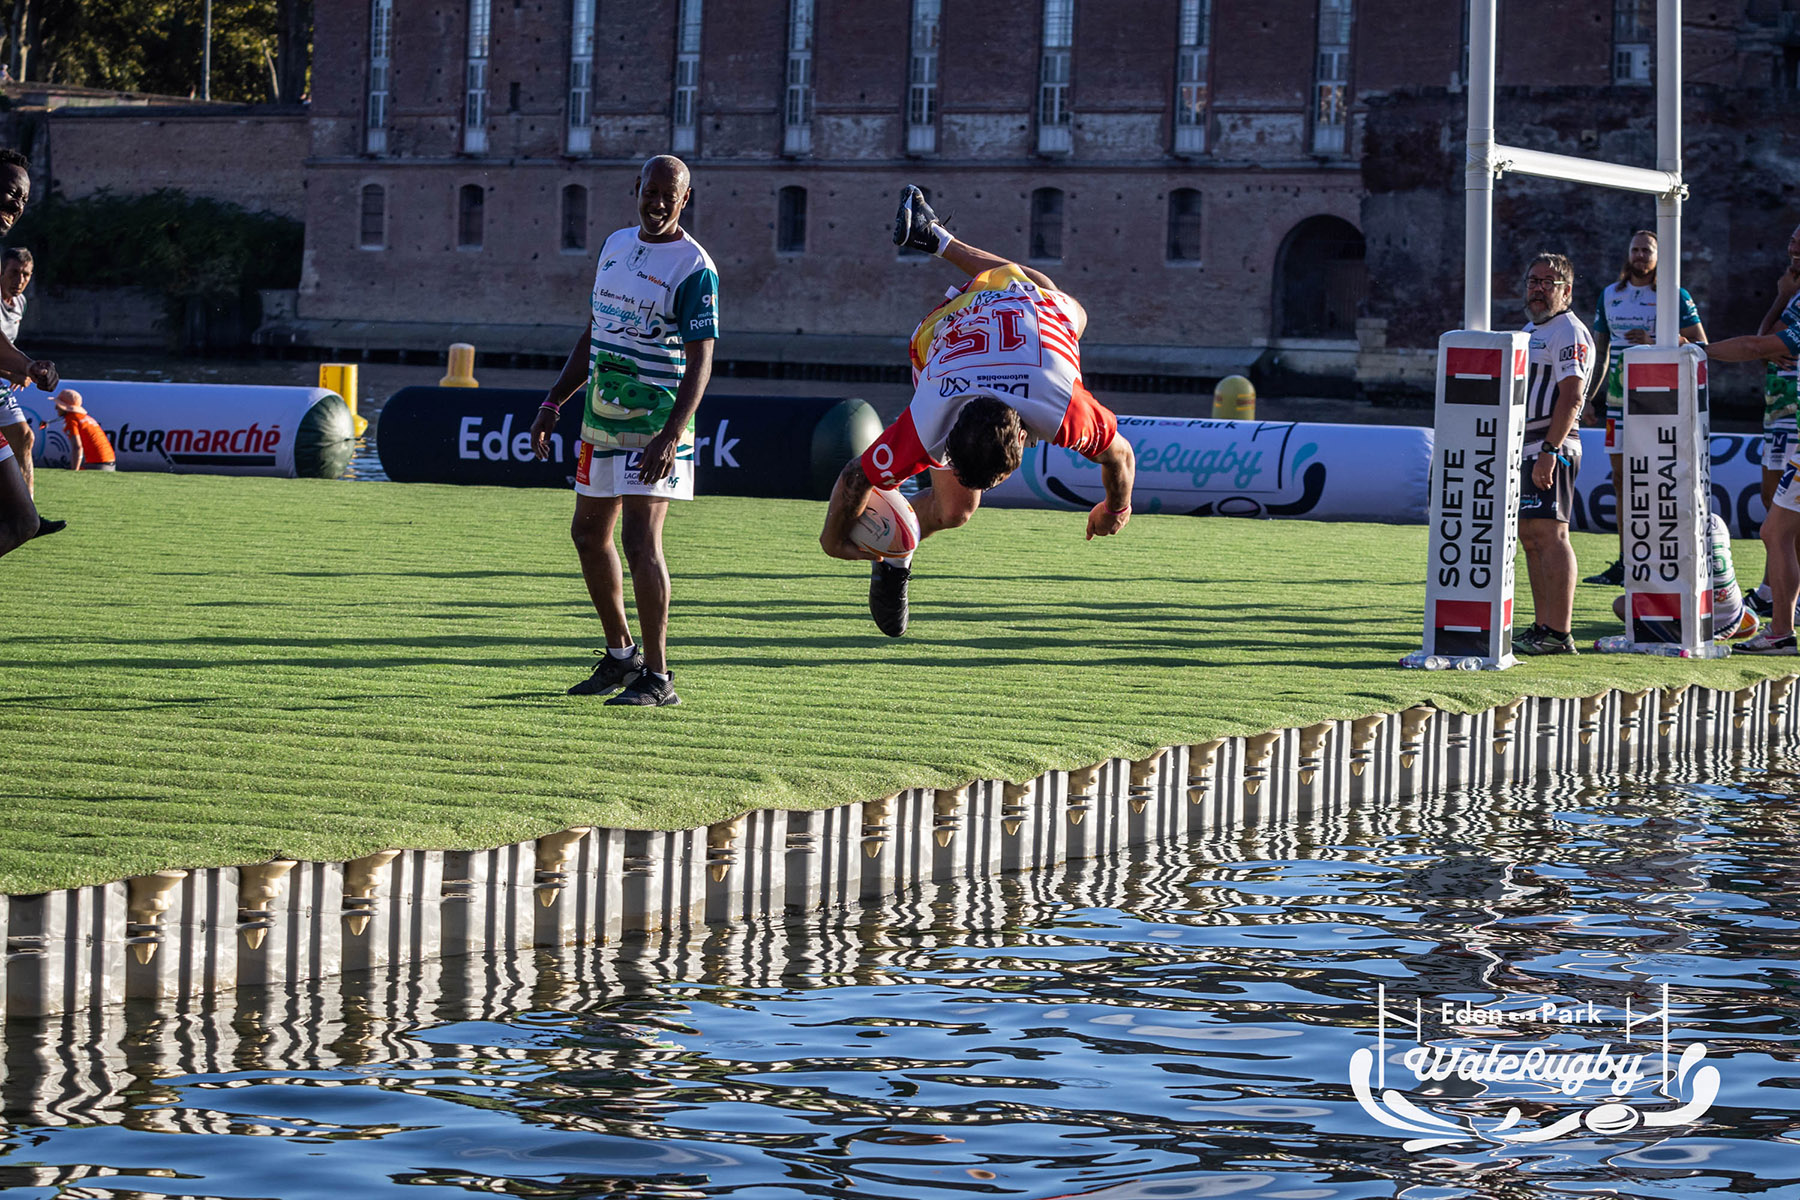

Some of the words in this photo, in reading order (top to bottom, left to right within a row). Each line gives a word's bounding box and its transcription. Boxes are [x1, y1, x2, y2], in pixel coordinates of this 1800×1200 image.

[600, 289, 615, 298] Eden
[621, 294, 635, 305] Park
[459, 414, 563, 463] Eden
[1116, 417, 1156, 427] den
[1186, 418, 1239, 431] Park
[1438, 449, 1465, 588] SOCIETE
[1469, 417, 1498, 589] GENERALE
[1629, 456, 1651, 582] SOCIETE
[1657, 426, 1680, 582] GENERALE
